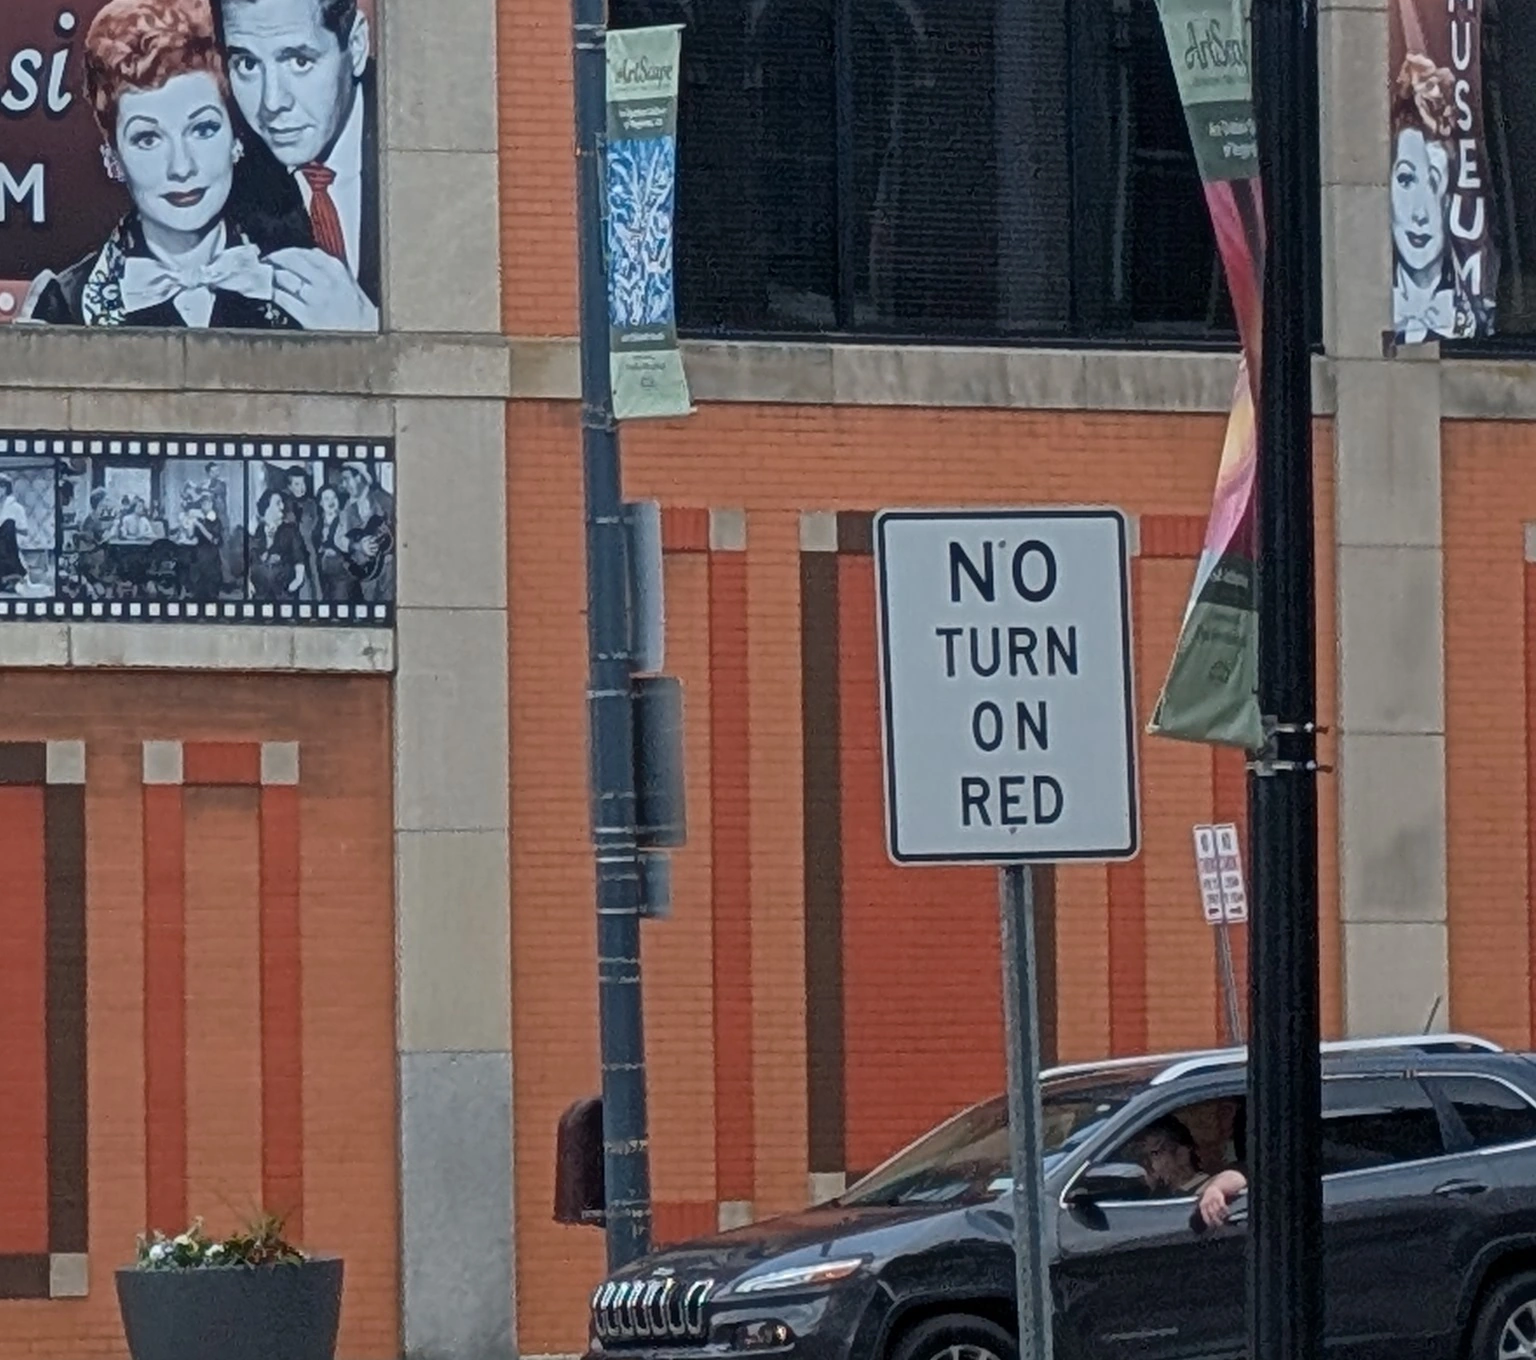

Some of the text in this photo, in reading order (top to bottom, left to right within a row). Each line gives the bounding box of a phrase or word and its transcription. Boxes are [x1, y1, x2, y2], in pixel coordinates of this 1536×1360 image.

[949, 539, 1057, 603] NO
[935, 625, 1079, 678] TURN
[972, 700, 1049, 752] ON
[961, 775, 1064, 827] RED
